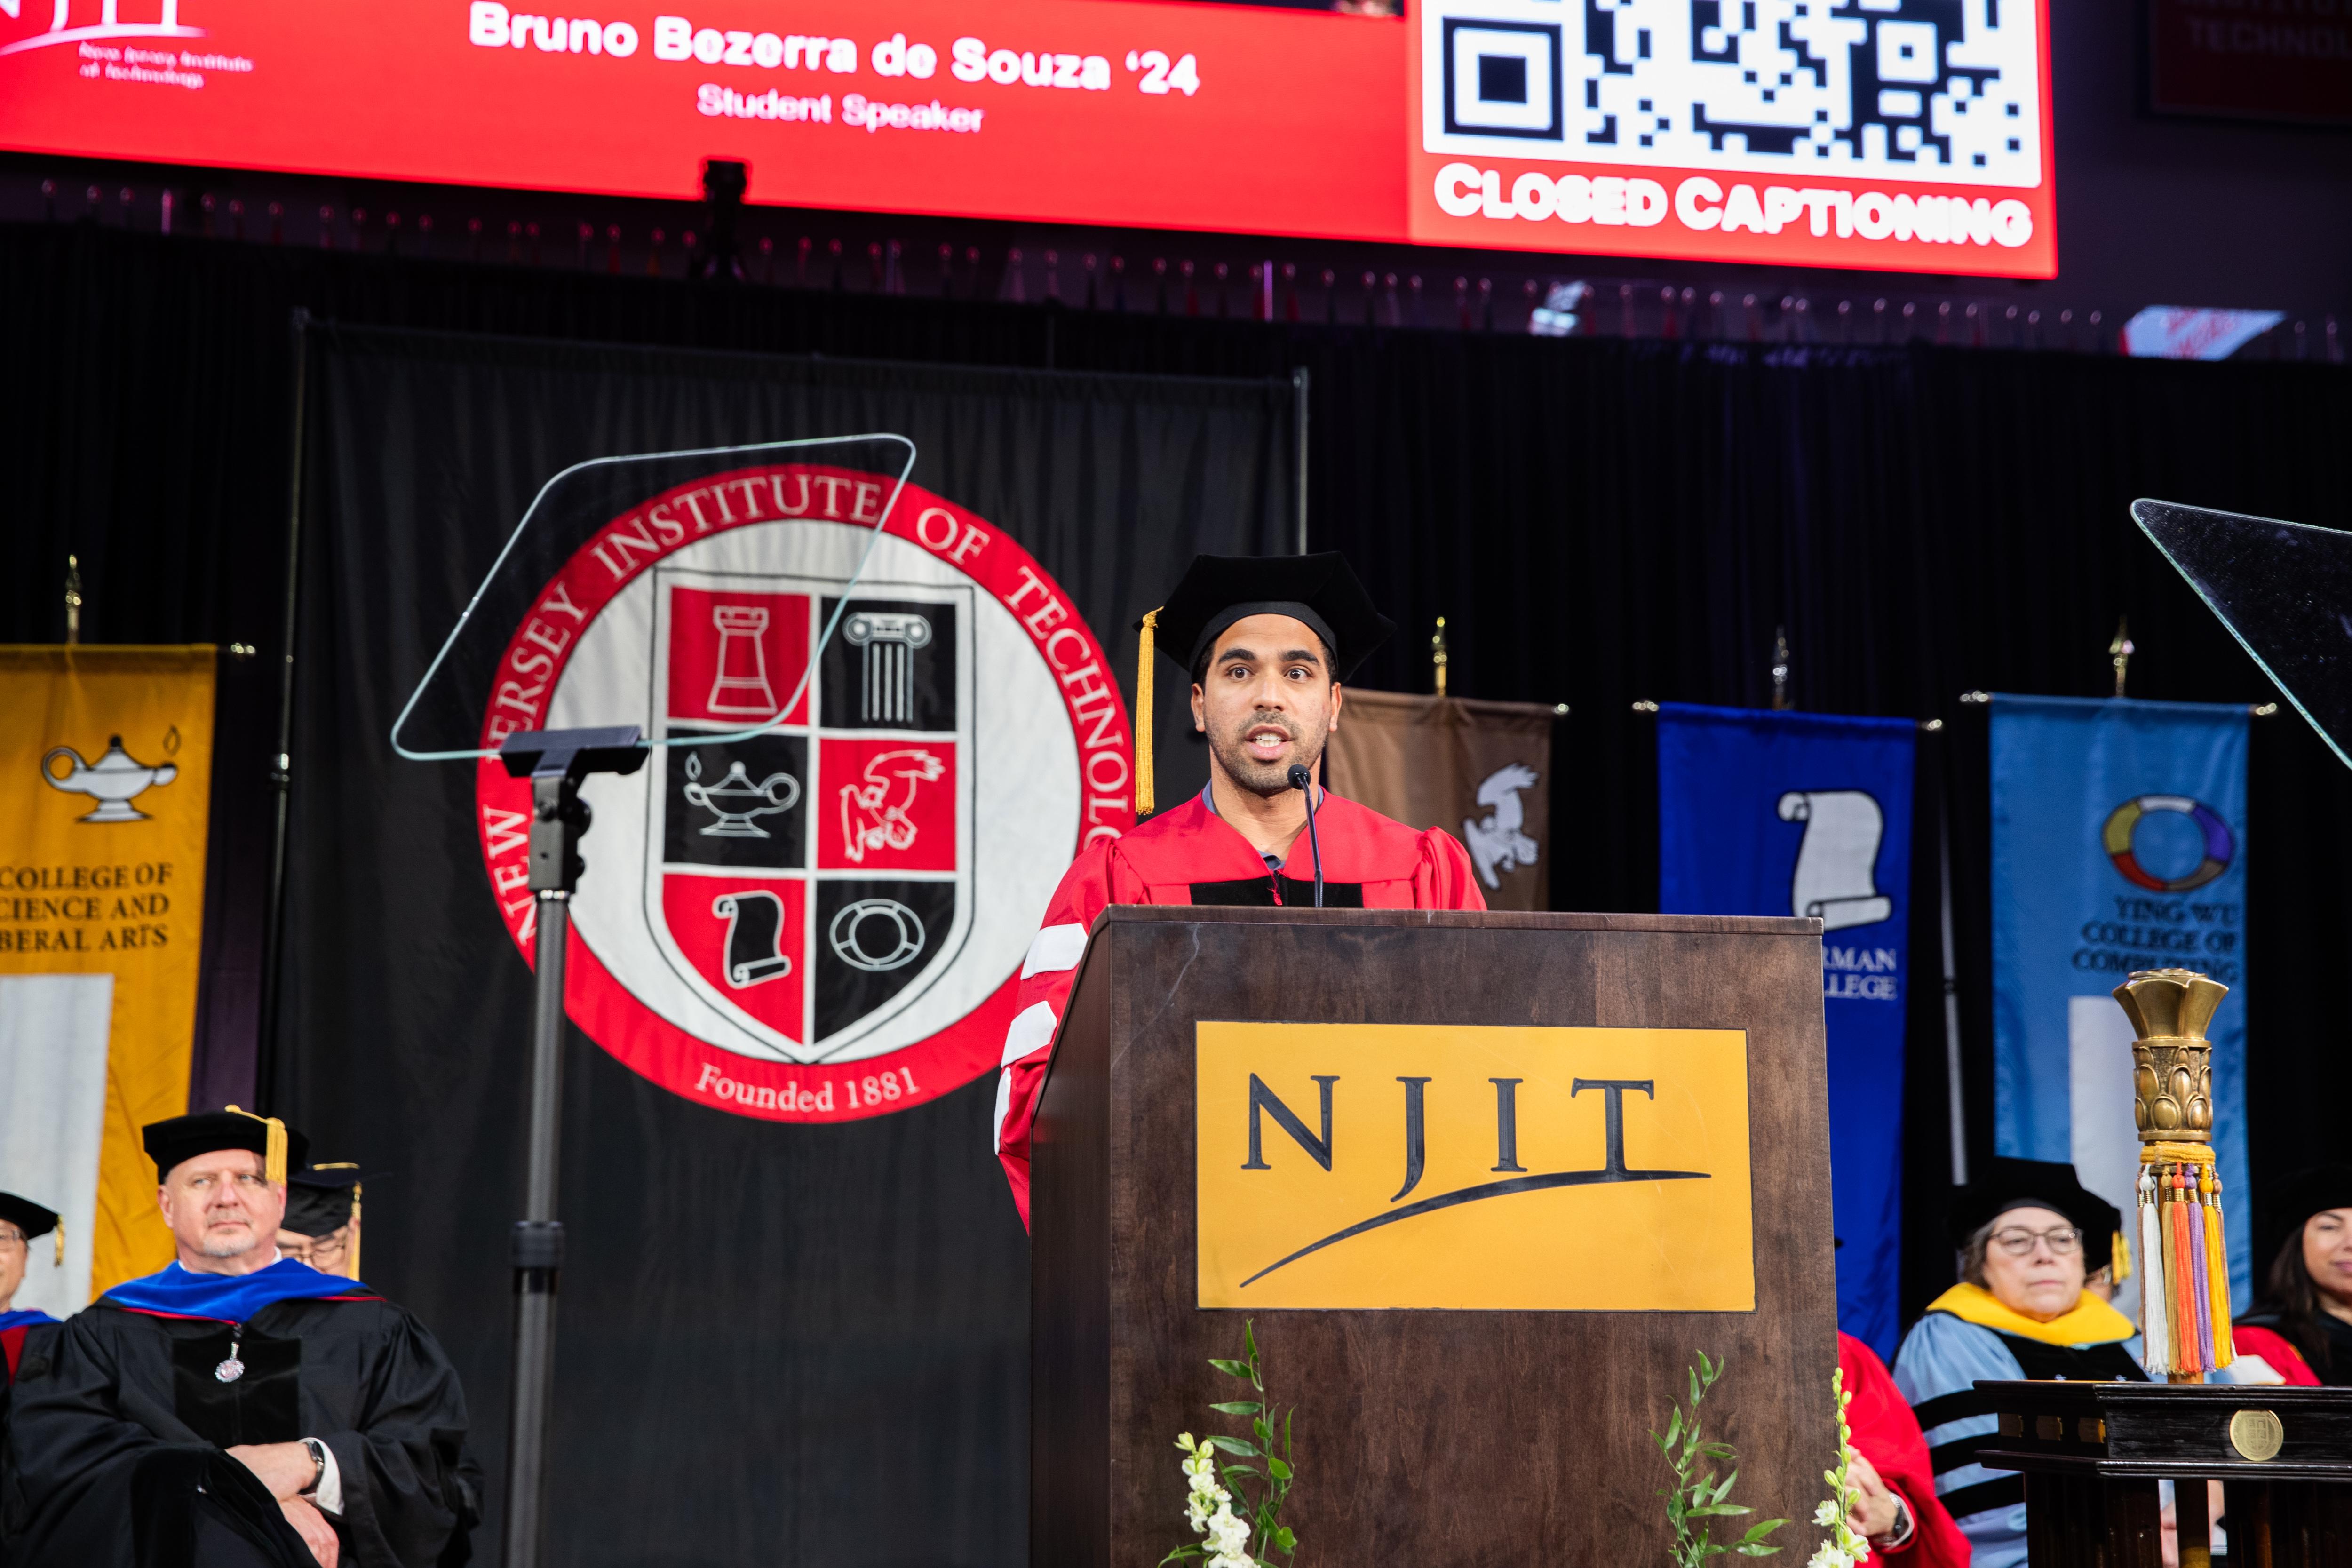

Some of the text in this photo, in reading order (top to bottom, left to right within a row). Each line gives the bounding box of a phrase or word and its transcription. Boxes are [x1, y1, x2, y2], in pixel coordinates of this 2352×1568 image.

[469, 0, 638, 58] Bruno
[654, 15, 858, 74] Bezerra
[871, 33, 938, 79] de
[951, 36, 1111, 90] Souza
[697, 83, 985, 133] Student Speaker
[1433, 162, 2033, 248] CLOSED CAPTIONING
[485, 580, 588, 764] ERSEY
[590, 473, 881, 583] INSTITUTE
[916, 507, 991, 566] OF
[0, 861, 174, 892] COLLEGE OF
[110, 892, 170, 921] AND
[99, 923, 169, 952] ARTS
[2081, 920, 2238, 955] COLLEGE OF
[1824, 973, 1898, 1001] LEGE
[694, 1062, 921, 1113] Founded 1881
[1240, 1073, 1655, 1202] NJIT
